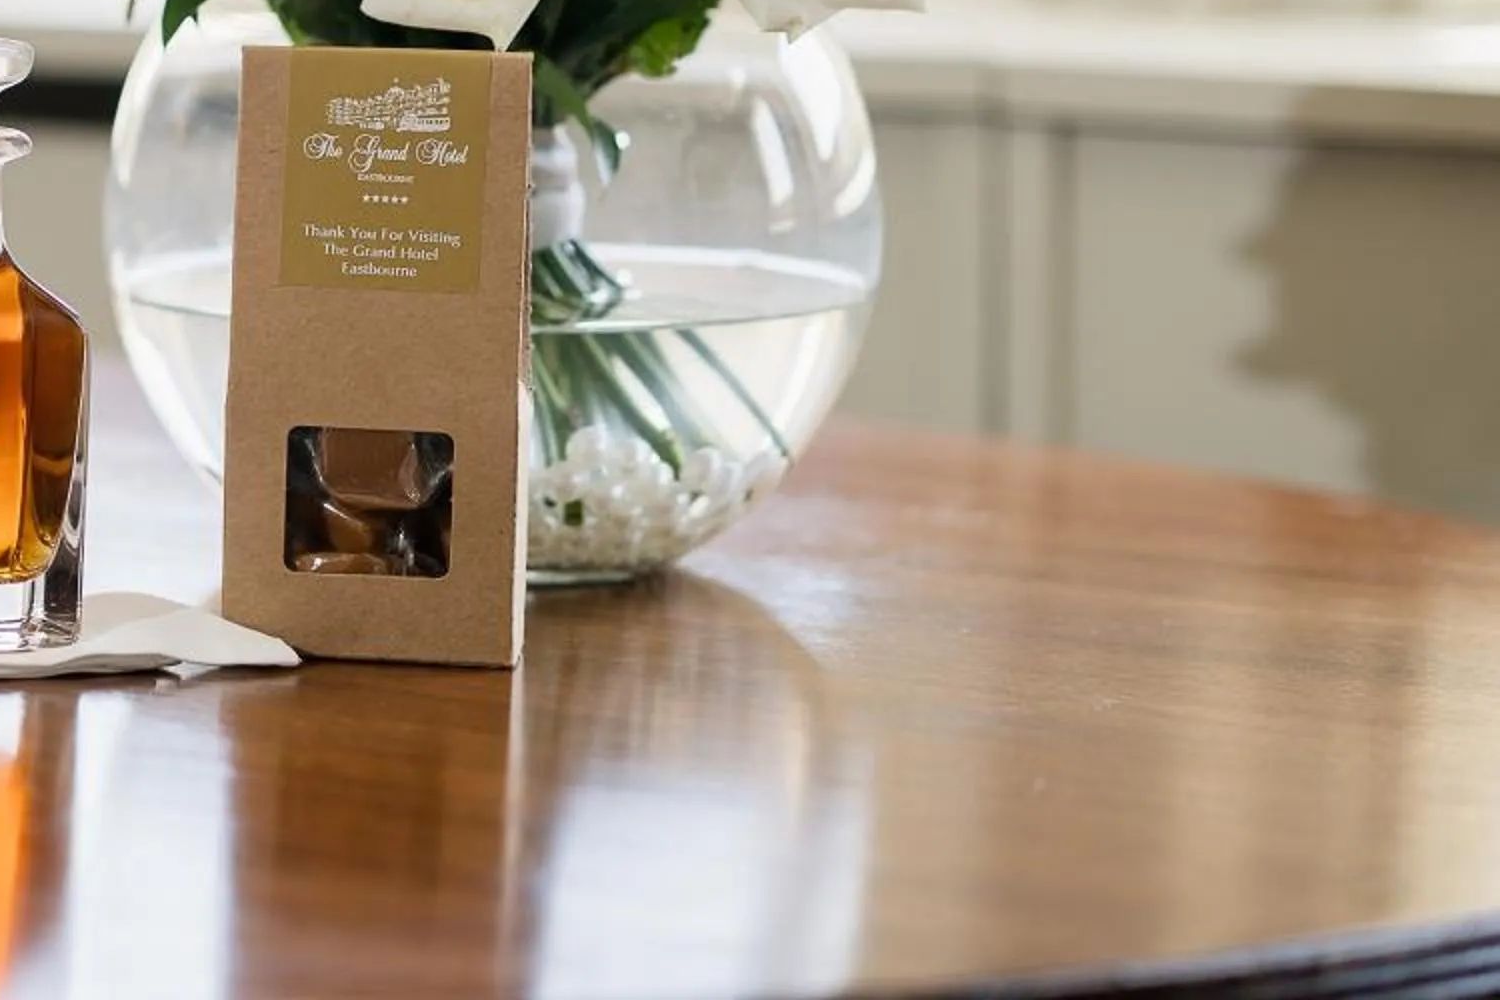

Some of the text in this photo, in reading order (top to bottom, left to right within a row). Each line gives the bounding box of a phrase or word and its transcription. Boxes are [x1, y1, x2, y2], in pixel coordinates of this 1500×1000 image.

[303, 133, 469, 173] The Grand Hotel
[304, 223, 461, 248] Thank You For Visiting
[324, 243, 439, 261] The Grand Hotel
[341, 261, 417, 277] Eastbourne
